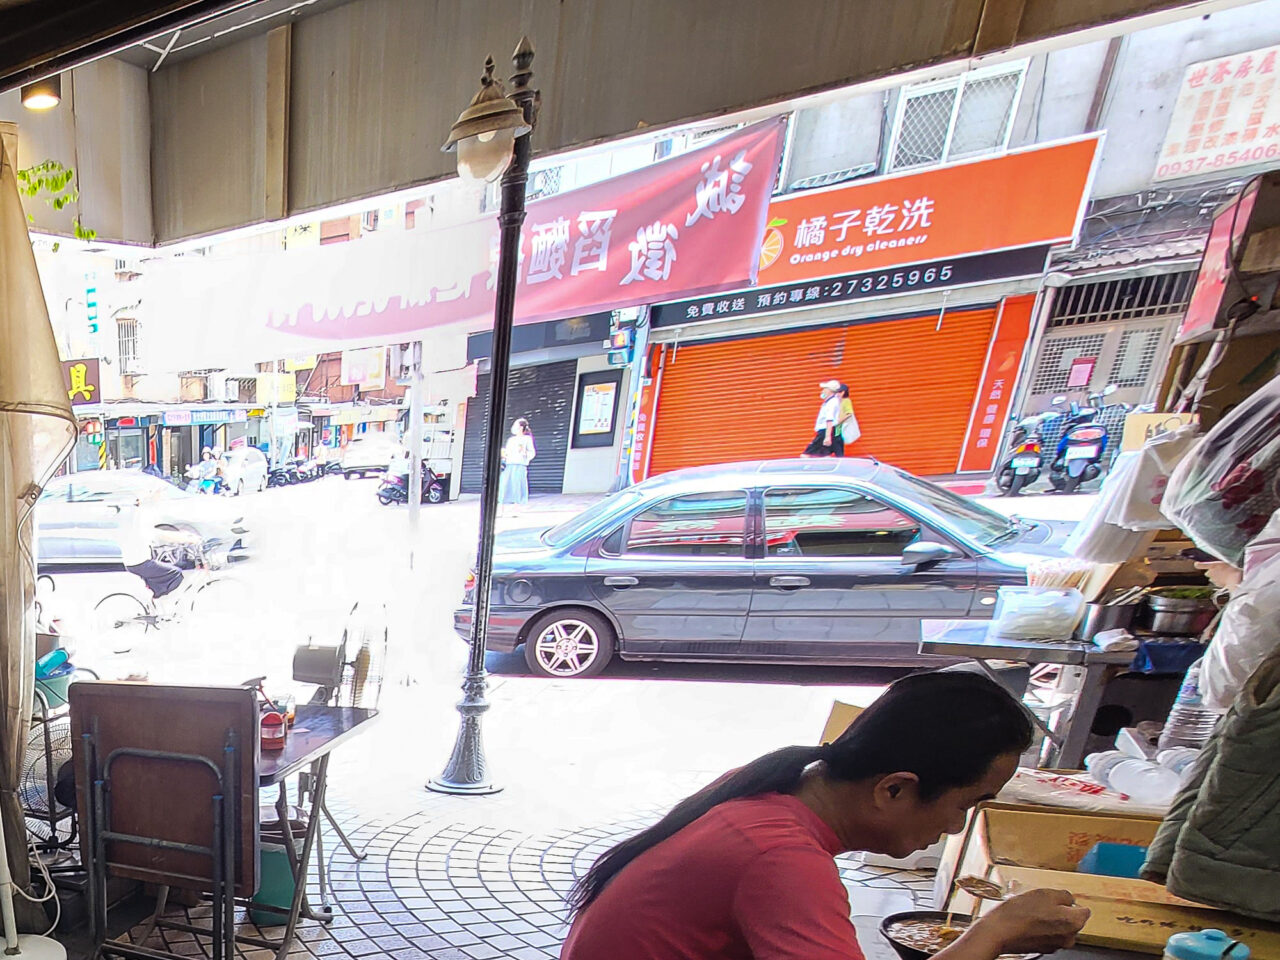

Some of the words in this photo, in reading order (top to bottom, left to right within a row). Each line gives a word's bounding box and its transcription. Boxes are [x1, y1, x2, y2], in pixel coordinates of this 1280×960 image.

[793, 196, 935, 249] 橘子乾洗
[789, 248, 839, 265] Orange
[841, 244, 864, 258] dry
[866, 234, 928, 251] cleaners
[686, 298, 746, 319] 免費收送
